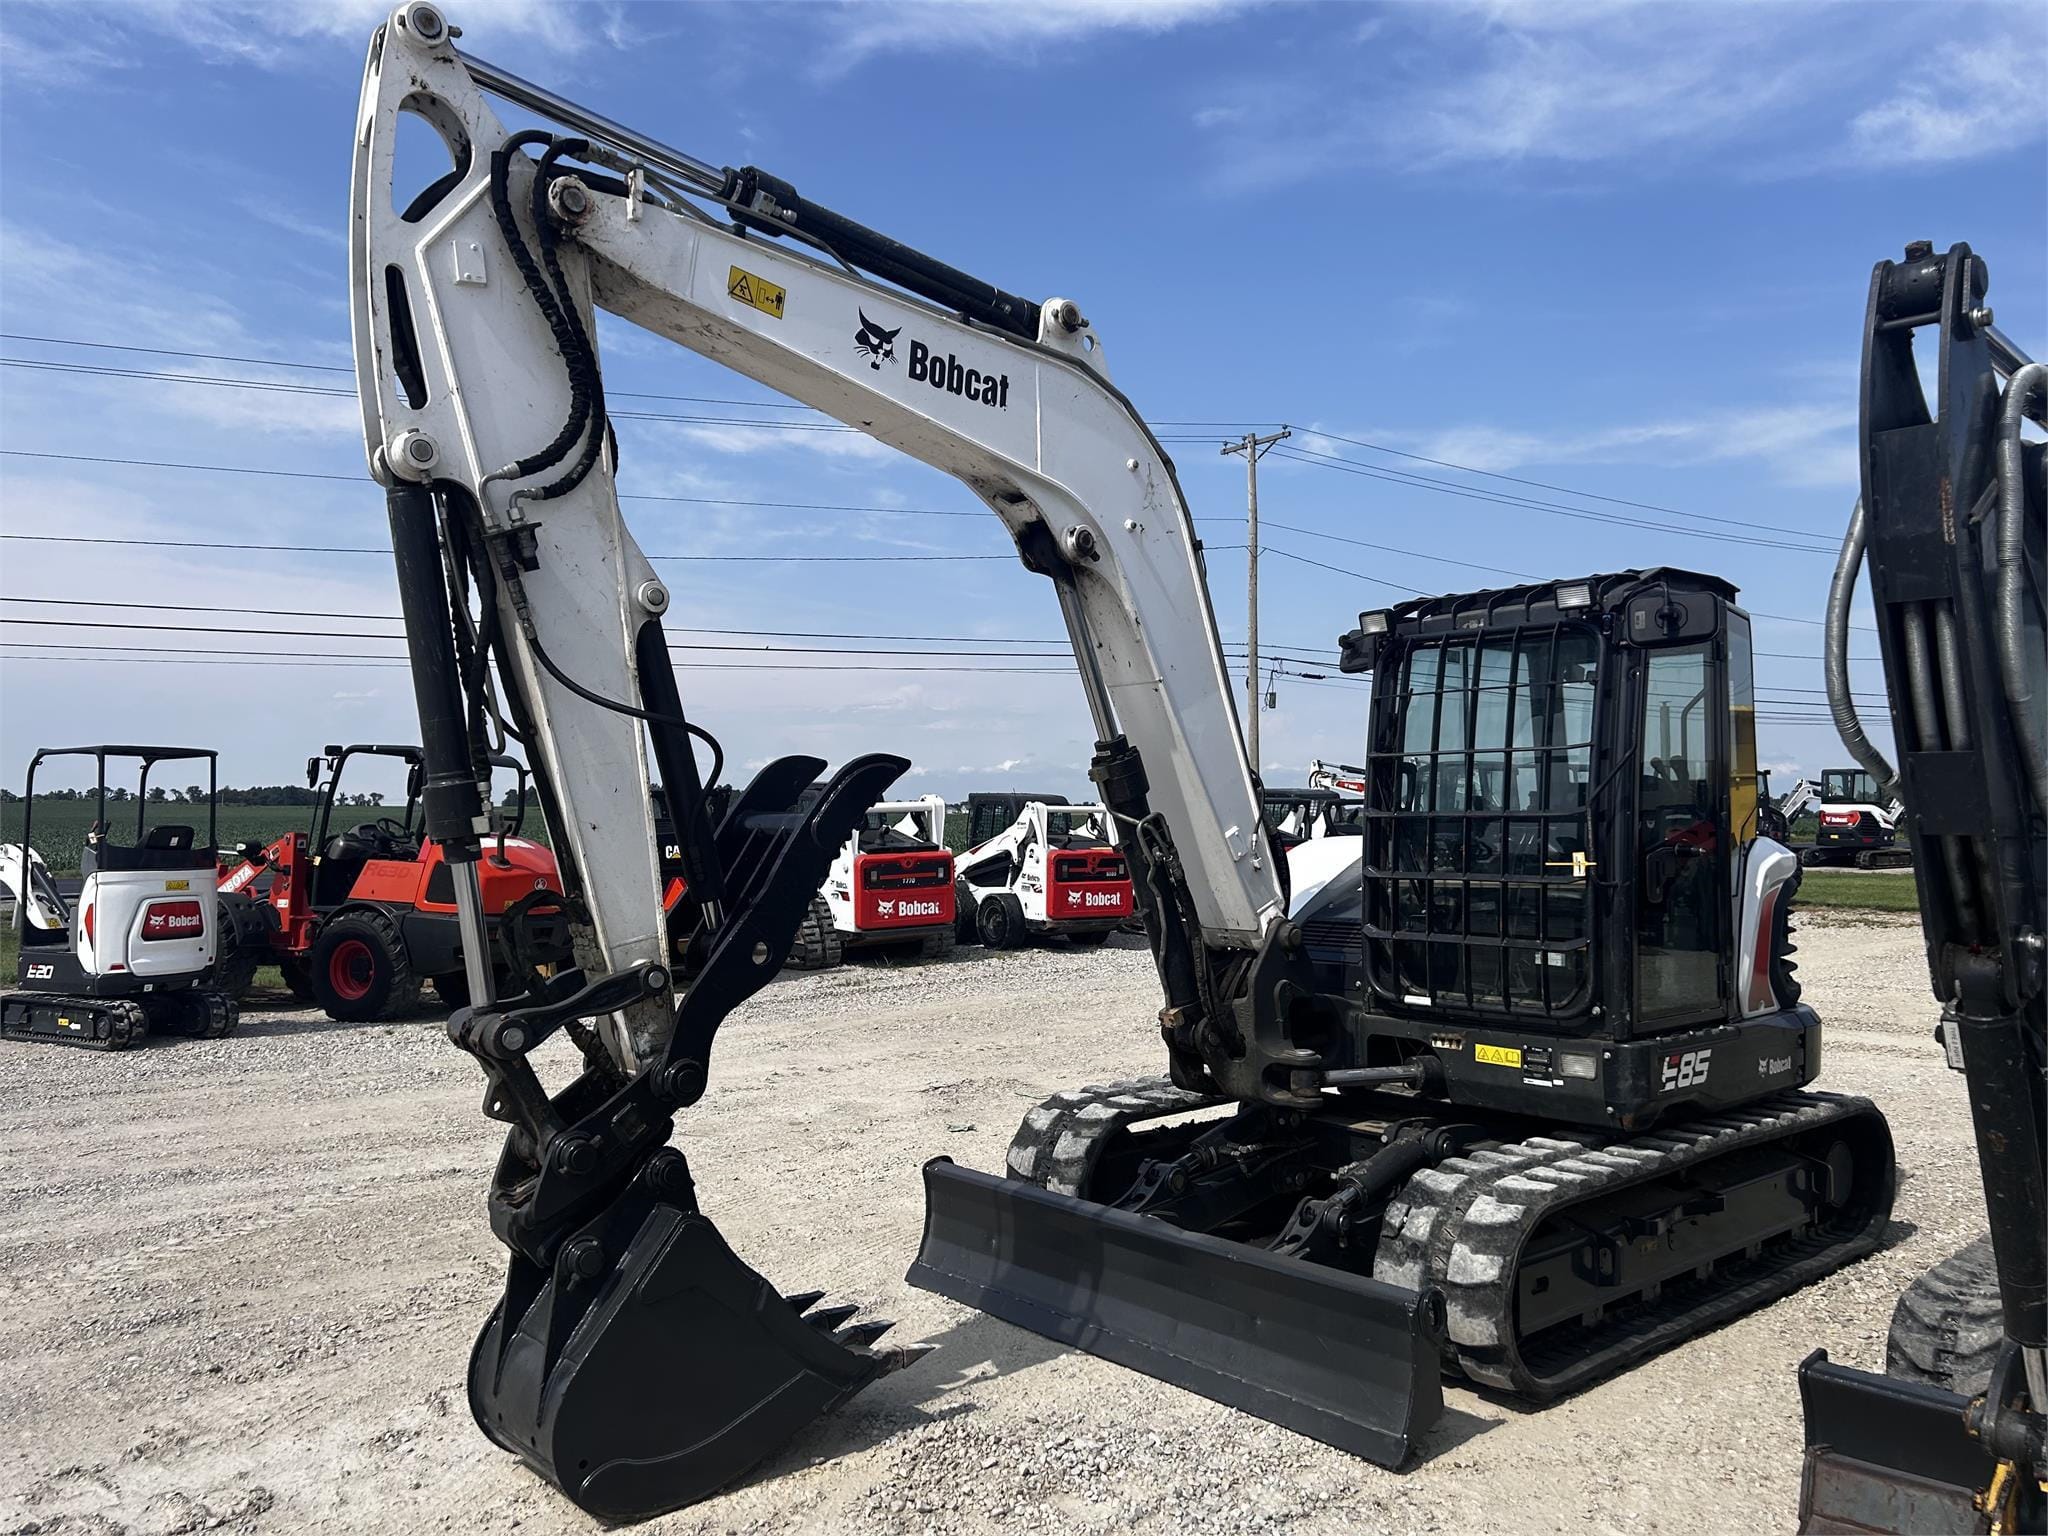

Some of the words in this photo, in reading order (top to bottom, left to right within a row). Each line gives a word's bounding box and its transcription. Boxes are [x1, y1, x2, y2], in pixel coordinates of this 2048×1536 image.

[908, 339, 1010, 409] Bobcat
[665, 844, 682, 859] CA
[1085, 891, 1121, 907] Bobcat
[898, 900, 940, 917] Bobcat
[168, 914, 201, 928] Bobcat
[27, 963, 54, 979] E20
[1659, 1049, 1712, 1093] E85
[1768, 1055, 1792, 1075] Bobcat
